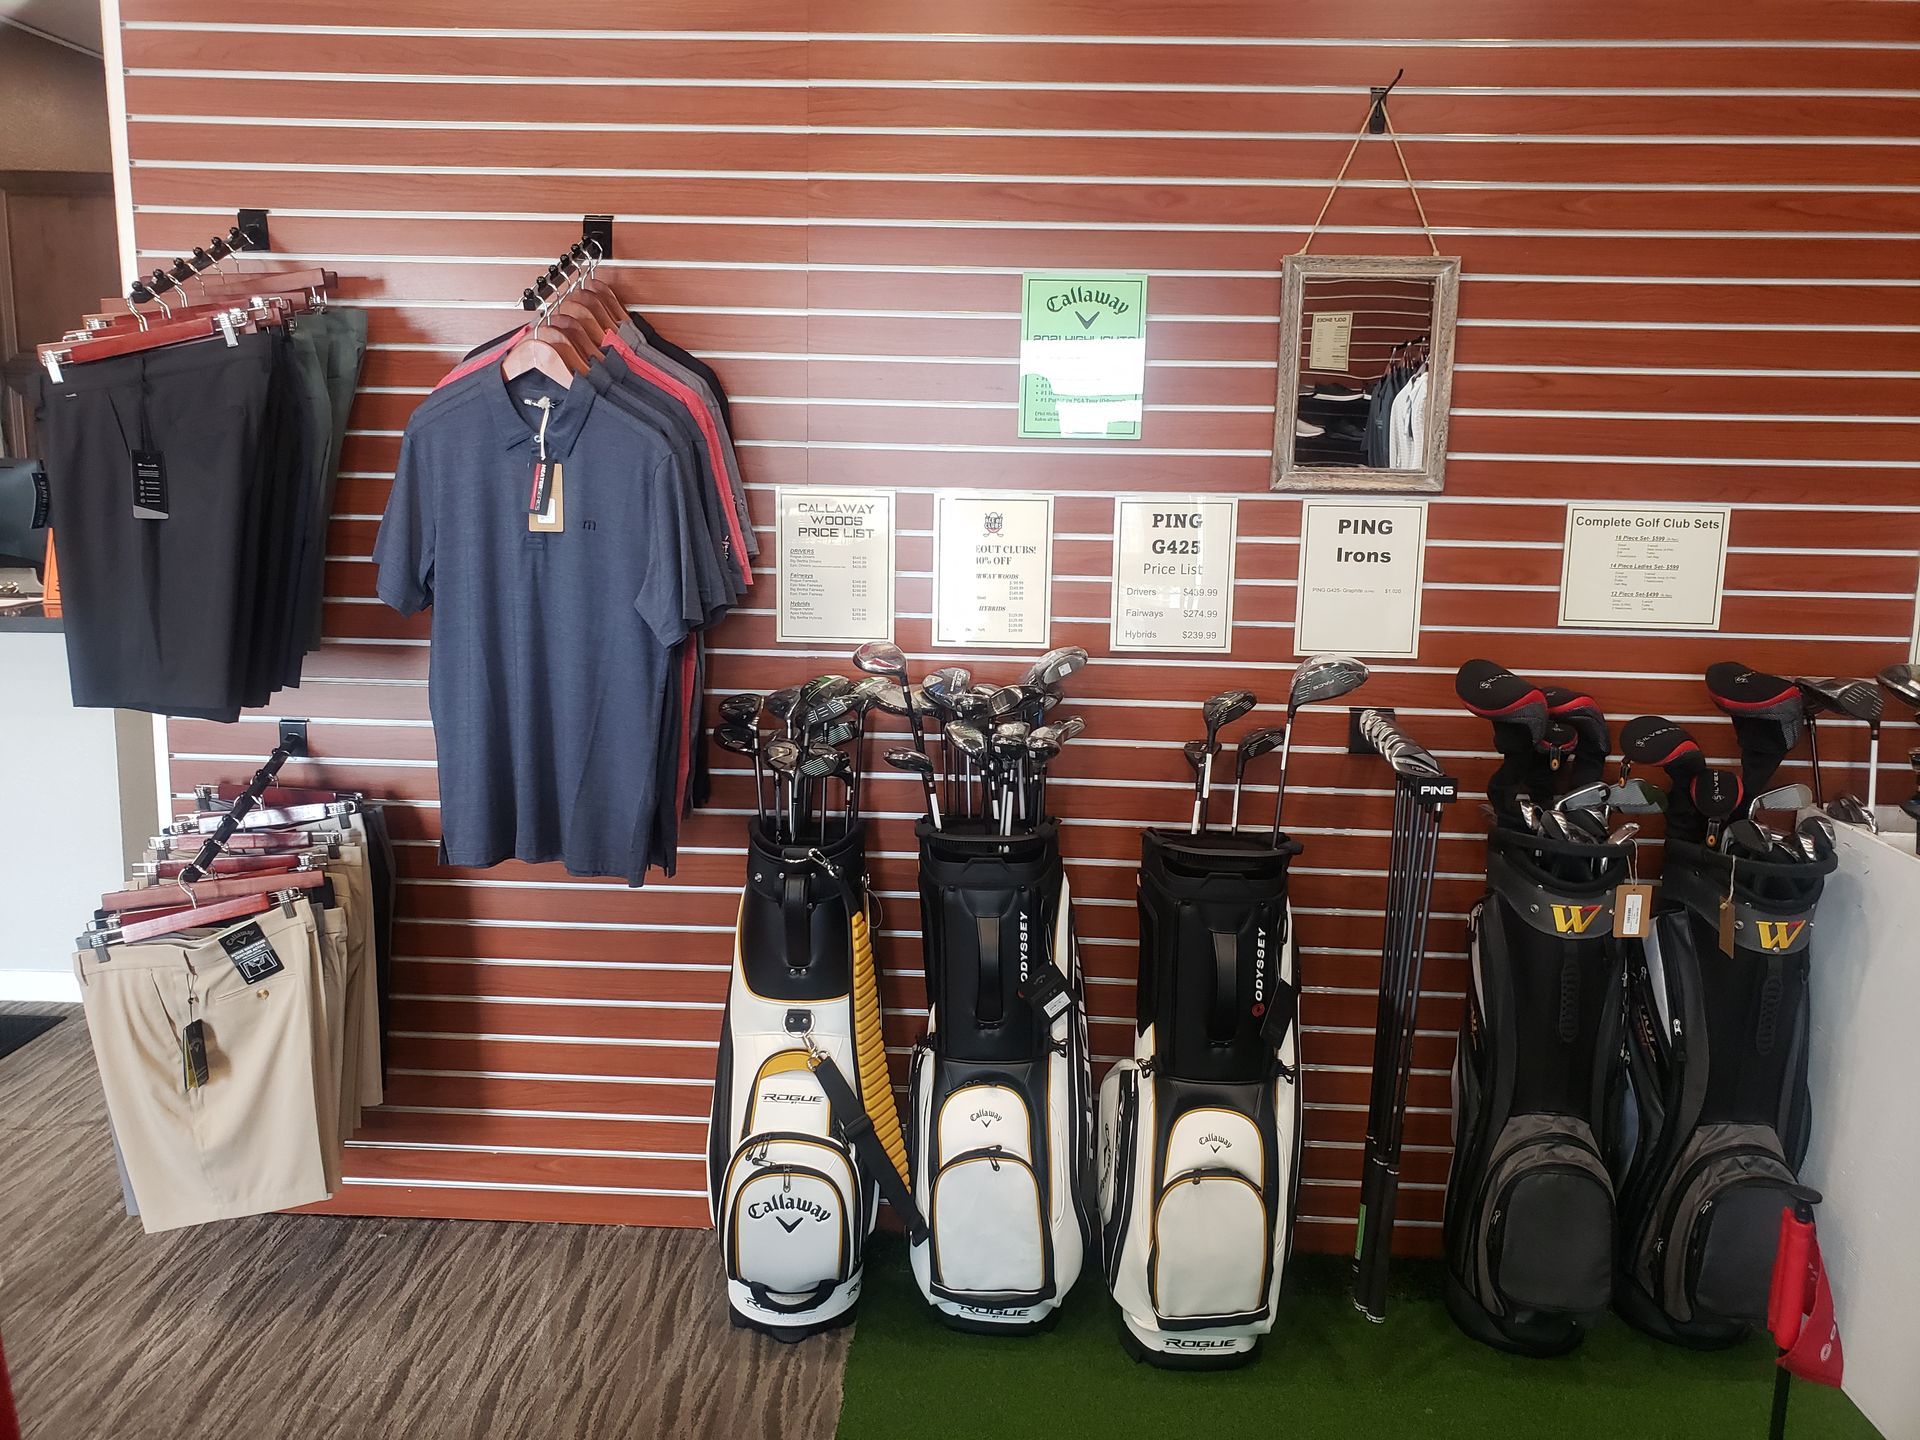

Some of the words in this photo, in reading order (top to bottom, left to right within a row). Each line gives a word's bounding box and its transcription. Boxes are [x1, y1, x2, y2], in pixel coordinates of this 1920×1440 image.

[1046, 285, 1129, 315] Callaway
[798, 502, 875, 514] CALLAWAY
[810, 516, 863, 526] WOODS
[1152, 513, 1203, 529] PING
[1338, 519, 1393, 535] PING
[1576, 516, 1632, 528] Complete
[1635, 517, 1661, 528] Golf
[1663, 518, 1690, 528] Club
[1694, 519, 1720, 529] Sets
[798, 527, 840, 538] PRICE
[844, 528, 875, 538] LIST
[1003, 546, 1037, 554] CLUBS!
[1152, 539, 1200, 555] G425
[994, 557, 1012, 565] OFF
[1336, 548, 1392, 563] Irons
[1143, 563, 1176, 576] Price
[1181, 564, 1203, 576] List
[1126, 588, 1157, 596] Drivers
[1125, 608, 1164, 618] Fairways
[1183, 609, 1218, 618] $274.99
[1125, 630, 1158, 640] Hybrids
[1182, 630, 1217, 640] $239.99
[1420, 786, 1454, 796] PING
[1550, 904, 1603, 934] W
[226, 930, 255, 946] Callaway
[1756, 920, 1806, 949] W
[1020, 911, 1028, 982] ODYSSEY
[1255, 927, 1266, 1002] ODYSSEY
[761, 1093, 824, 1102] ROGUE
[970, 1108, 1002, 1122] Callaway
[1198, 1132, 1232, 1148] Callaway
[748, 1193, 832, 1222] Callaway
[958, 1304, 1031, 1316] ROGUE
[1163, 1338, 1238, 1348] ROGUE
